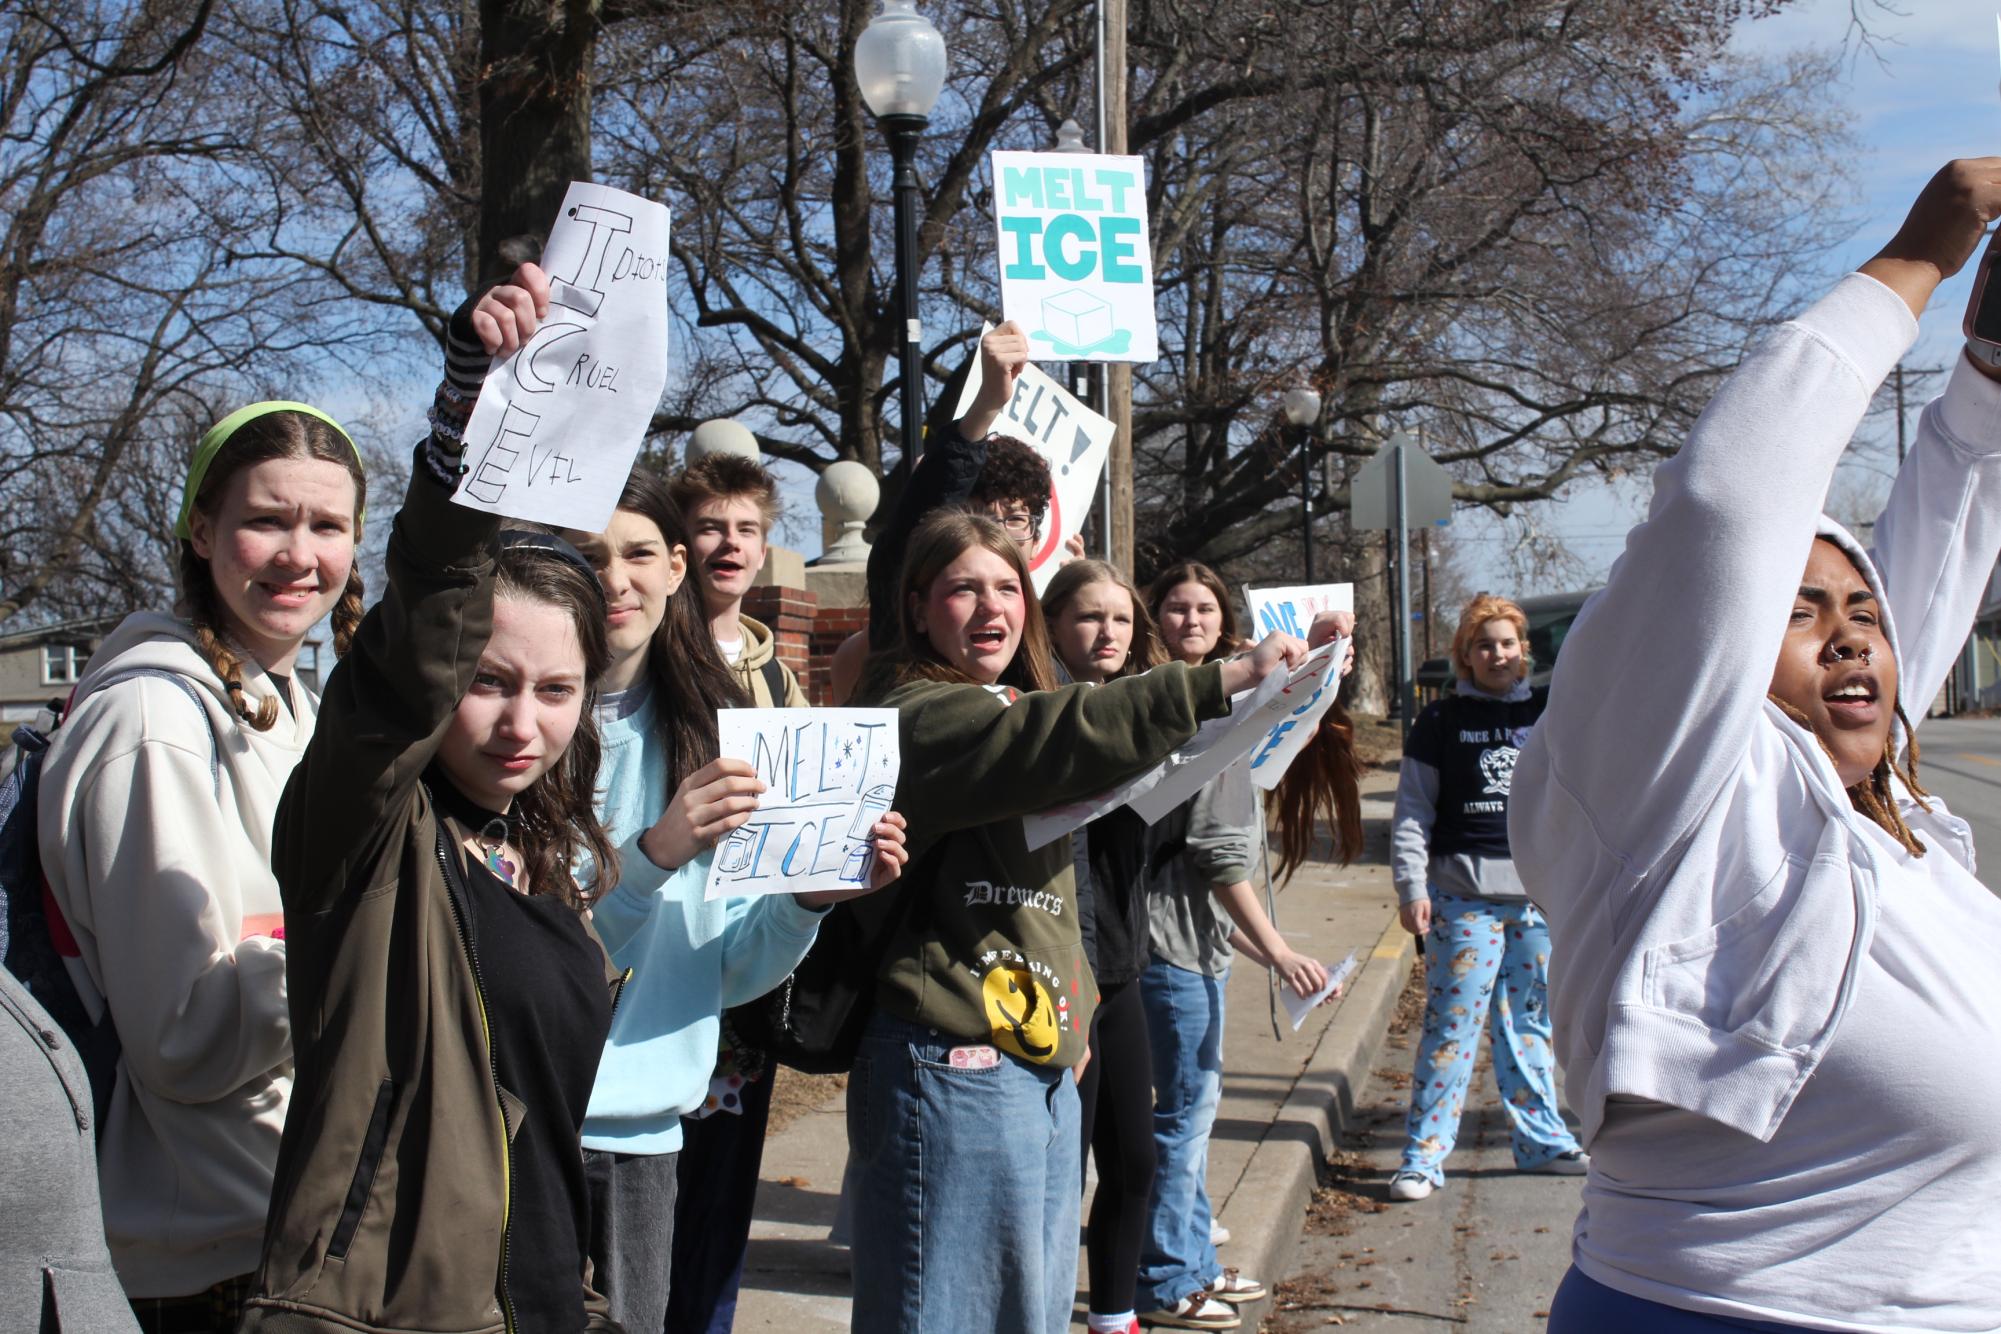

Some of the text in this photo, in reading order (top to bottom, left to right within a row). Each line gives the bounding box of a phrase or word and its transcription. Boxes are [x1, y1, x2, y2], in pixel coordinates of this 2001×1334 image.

[1003, 166, 1135, 213] MELT
[1001, 213, 1143, 283] ICE
[514, 322, 618, 393] CRUEL
[465, 399, 582, 504] EVIL
[1000, 377, 1092, 476] ELT!
[752, 721, 886, 802] MELT
[1460, 729, 1490, 743] ONCE
[1495, 728, 1503, 741] A
[1463, 801, 1505, 814] ALWAYS
[731, 814, 846, 881] ICE
